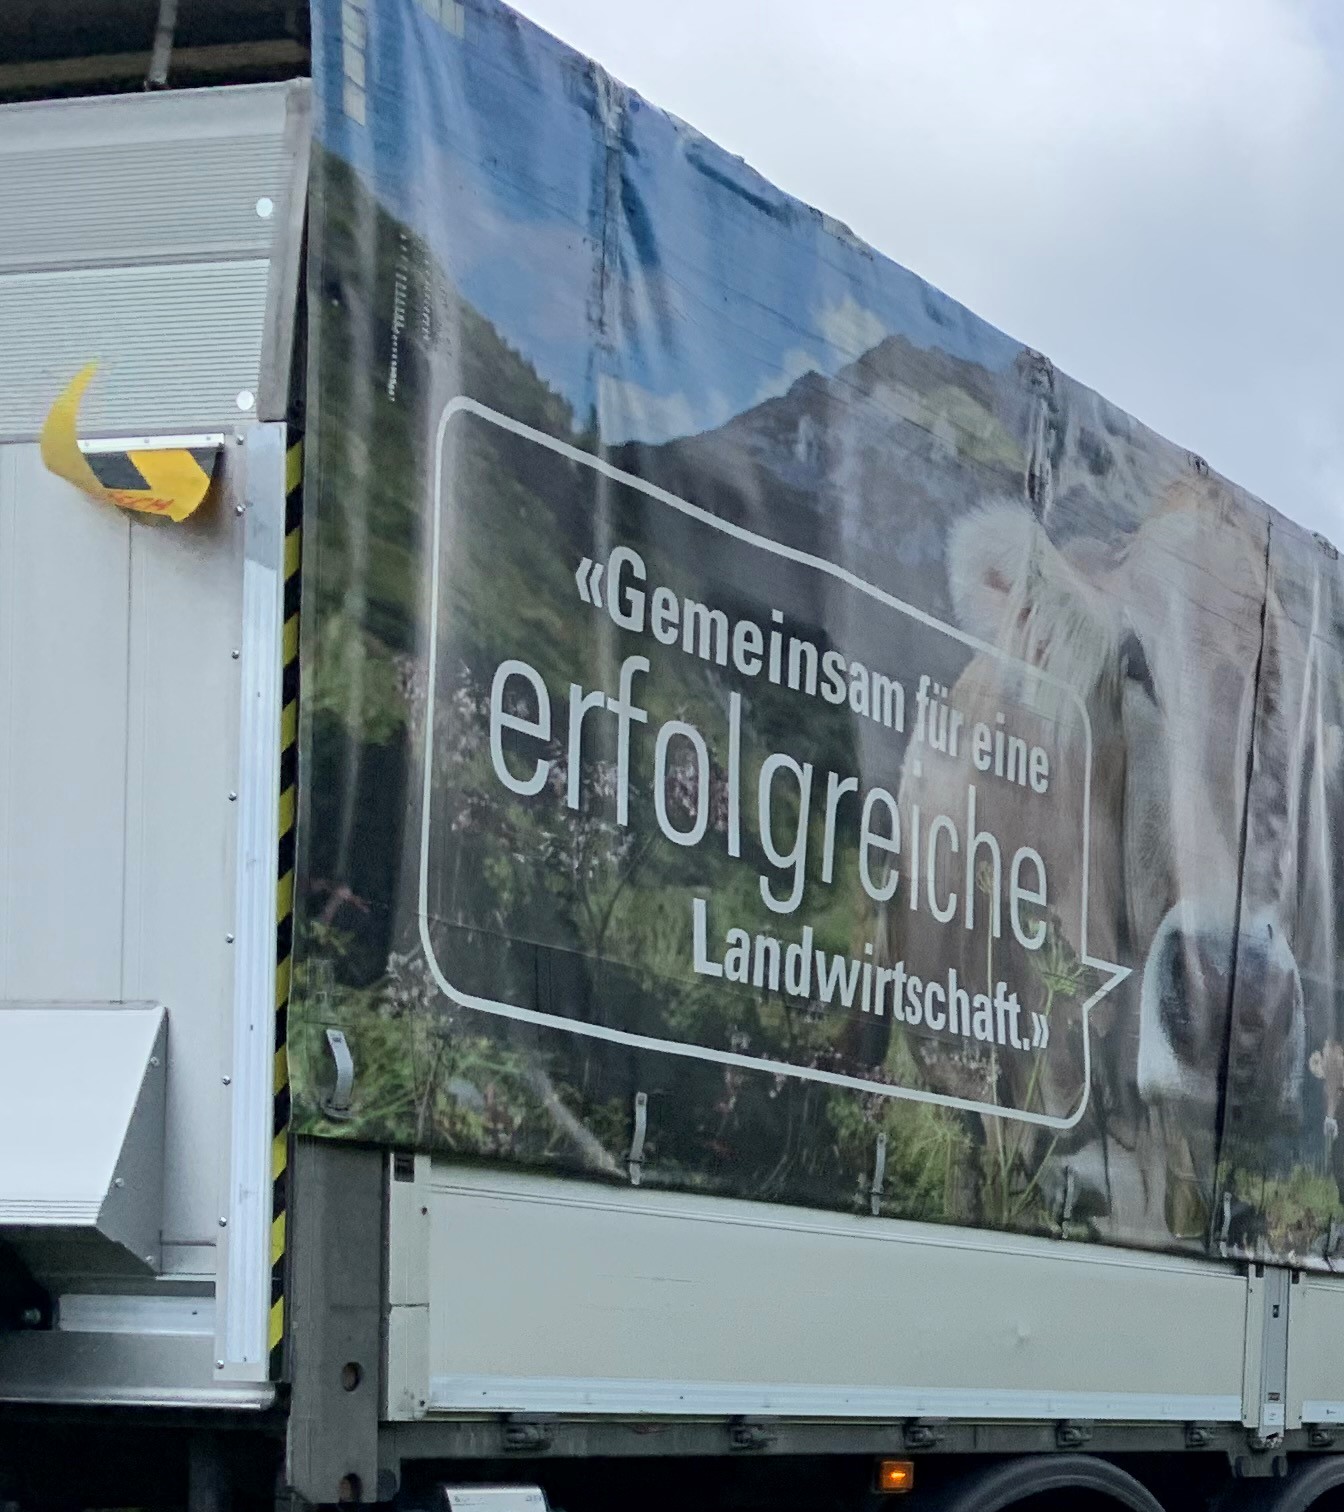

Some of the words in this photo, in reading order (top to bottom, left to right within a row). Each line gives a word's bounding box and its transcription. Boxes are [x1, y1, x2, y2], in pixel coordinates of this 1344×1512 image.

[575, 546, 904, 732] «Gemeinsam
[915, 676, 964, 758] für
[972, 712, 1049, 793] eine
[490, 655, 1047, 951] erfolgreiche
[693, 897, 1049, 1050] Landwirtschaft.»
